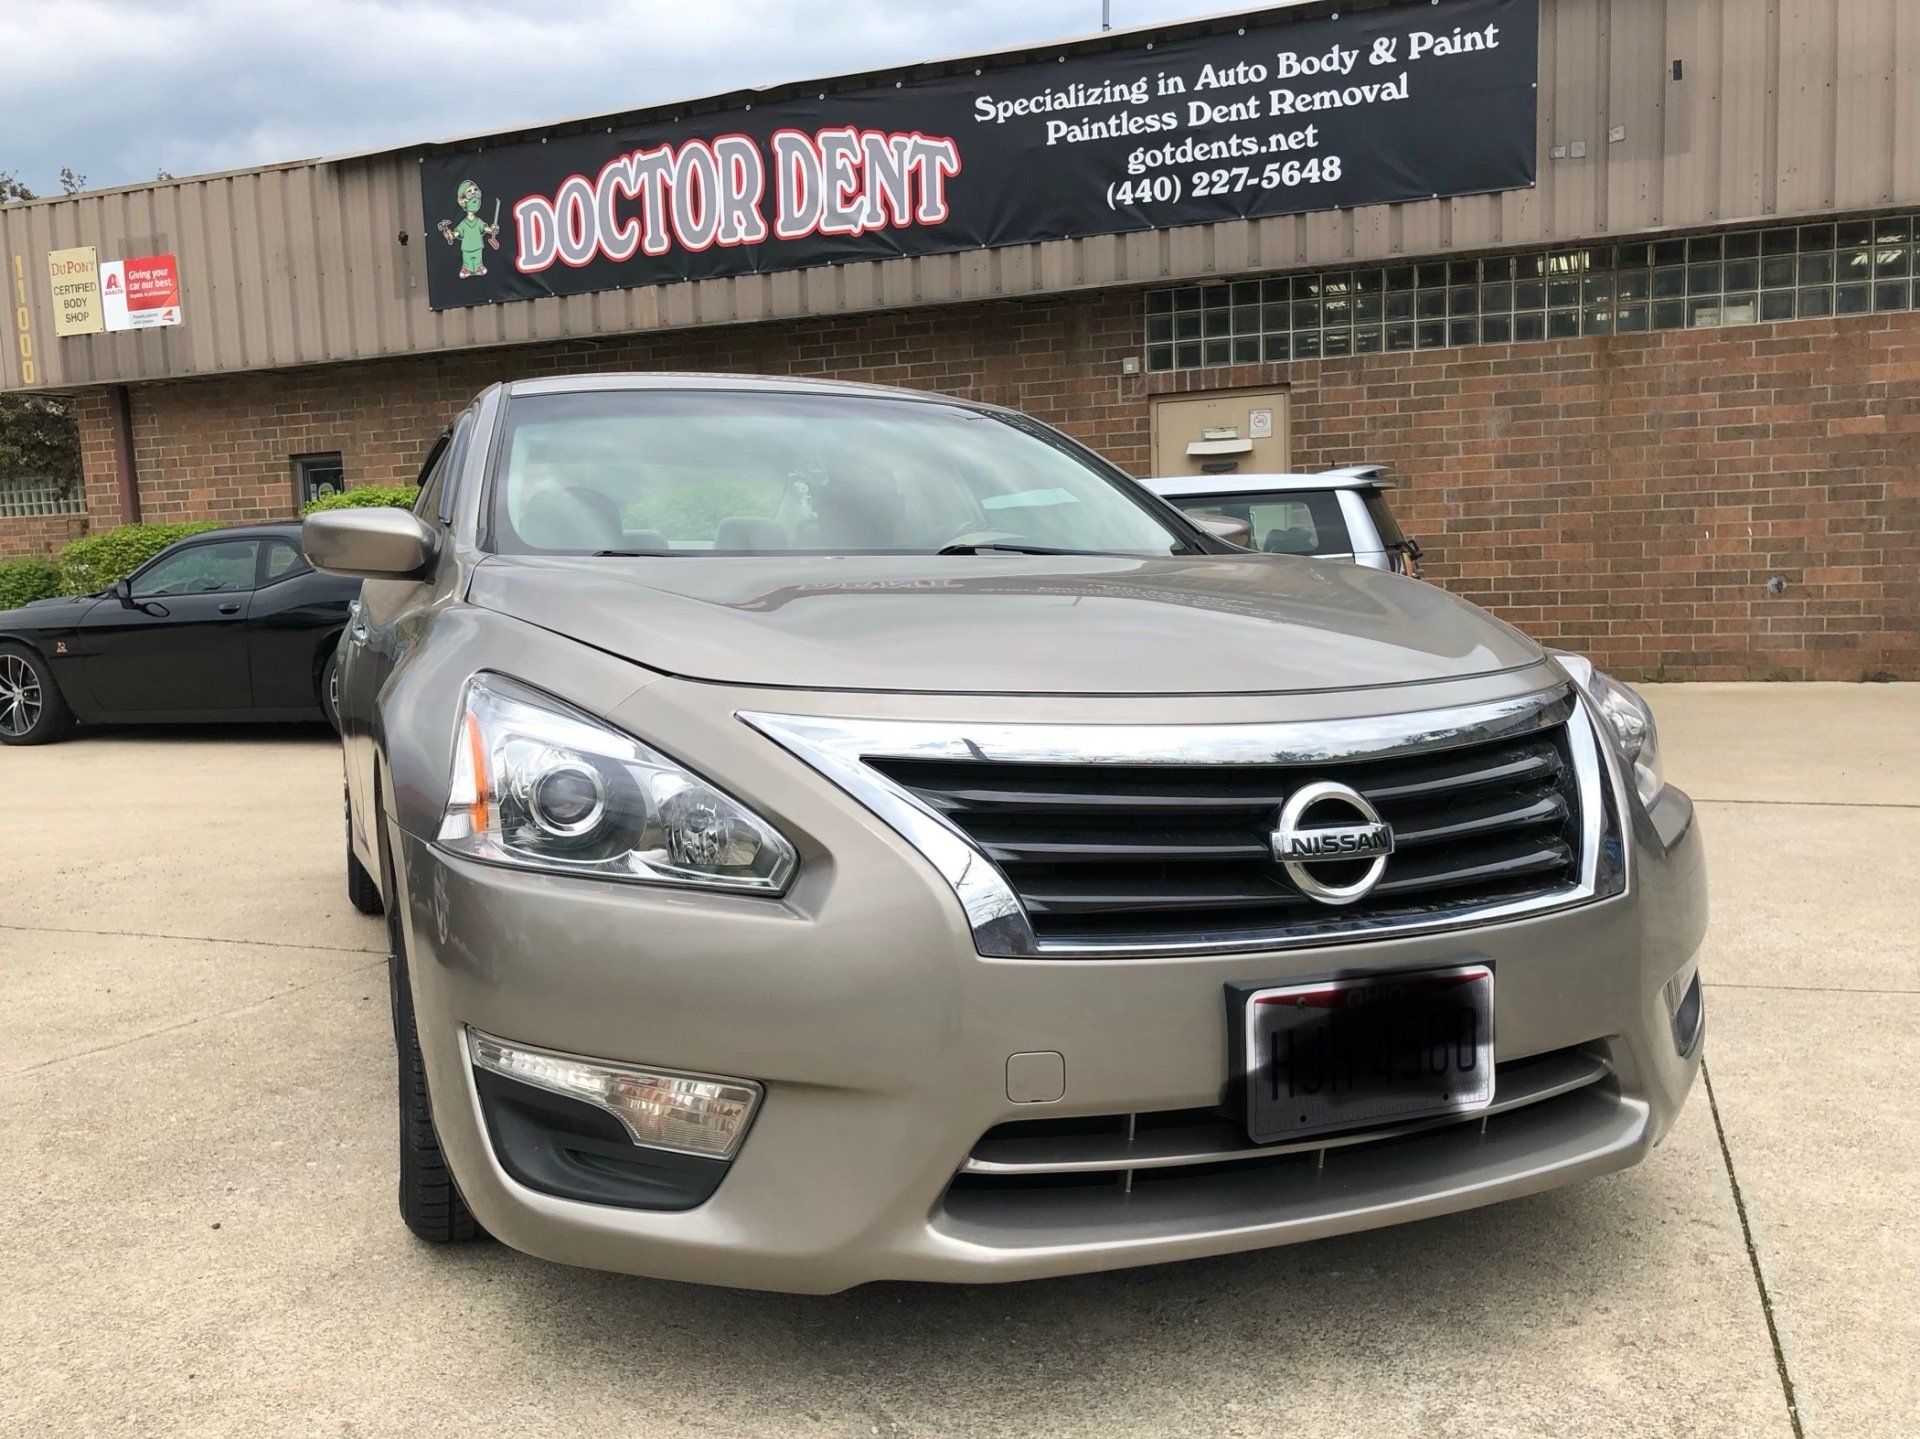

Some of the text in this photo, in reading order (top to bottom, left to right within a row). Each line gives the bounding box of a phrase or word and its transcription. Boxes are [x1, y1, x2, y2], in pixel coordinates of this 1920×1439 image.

[974, 23, 1499, 123] Specializing in Auto Body & Paint
[1046, 71, 1409, 145] Paintless Dent Removal
[1127, 123, 1319, 174] gotdents.net
[1106, 155, 1342, 210] (440) 227-5648
[513, 125, 961, 273] DOCTOR DENT
[53, 281, 96, 296] CERTIFIED
[128, 268, 168, 280] Giving your
[129, 282, 140, 291] car
[141, 281, 153, 289] our
[63, 297, 87, 309] BODY
[65, 312, 89, 323] SHOP
[1290, 826, 1389, 855] NISSAN
